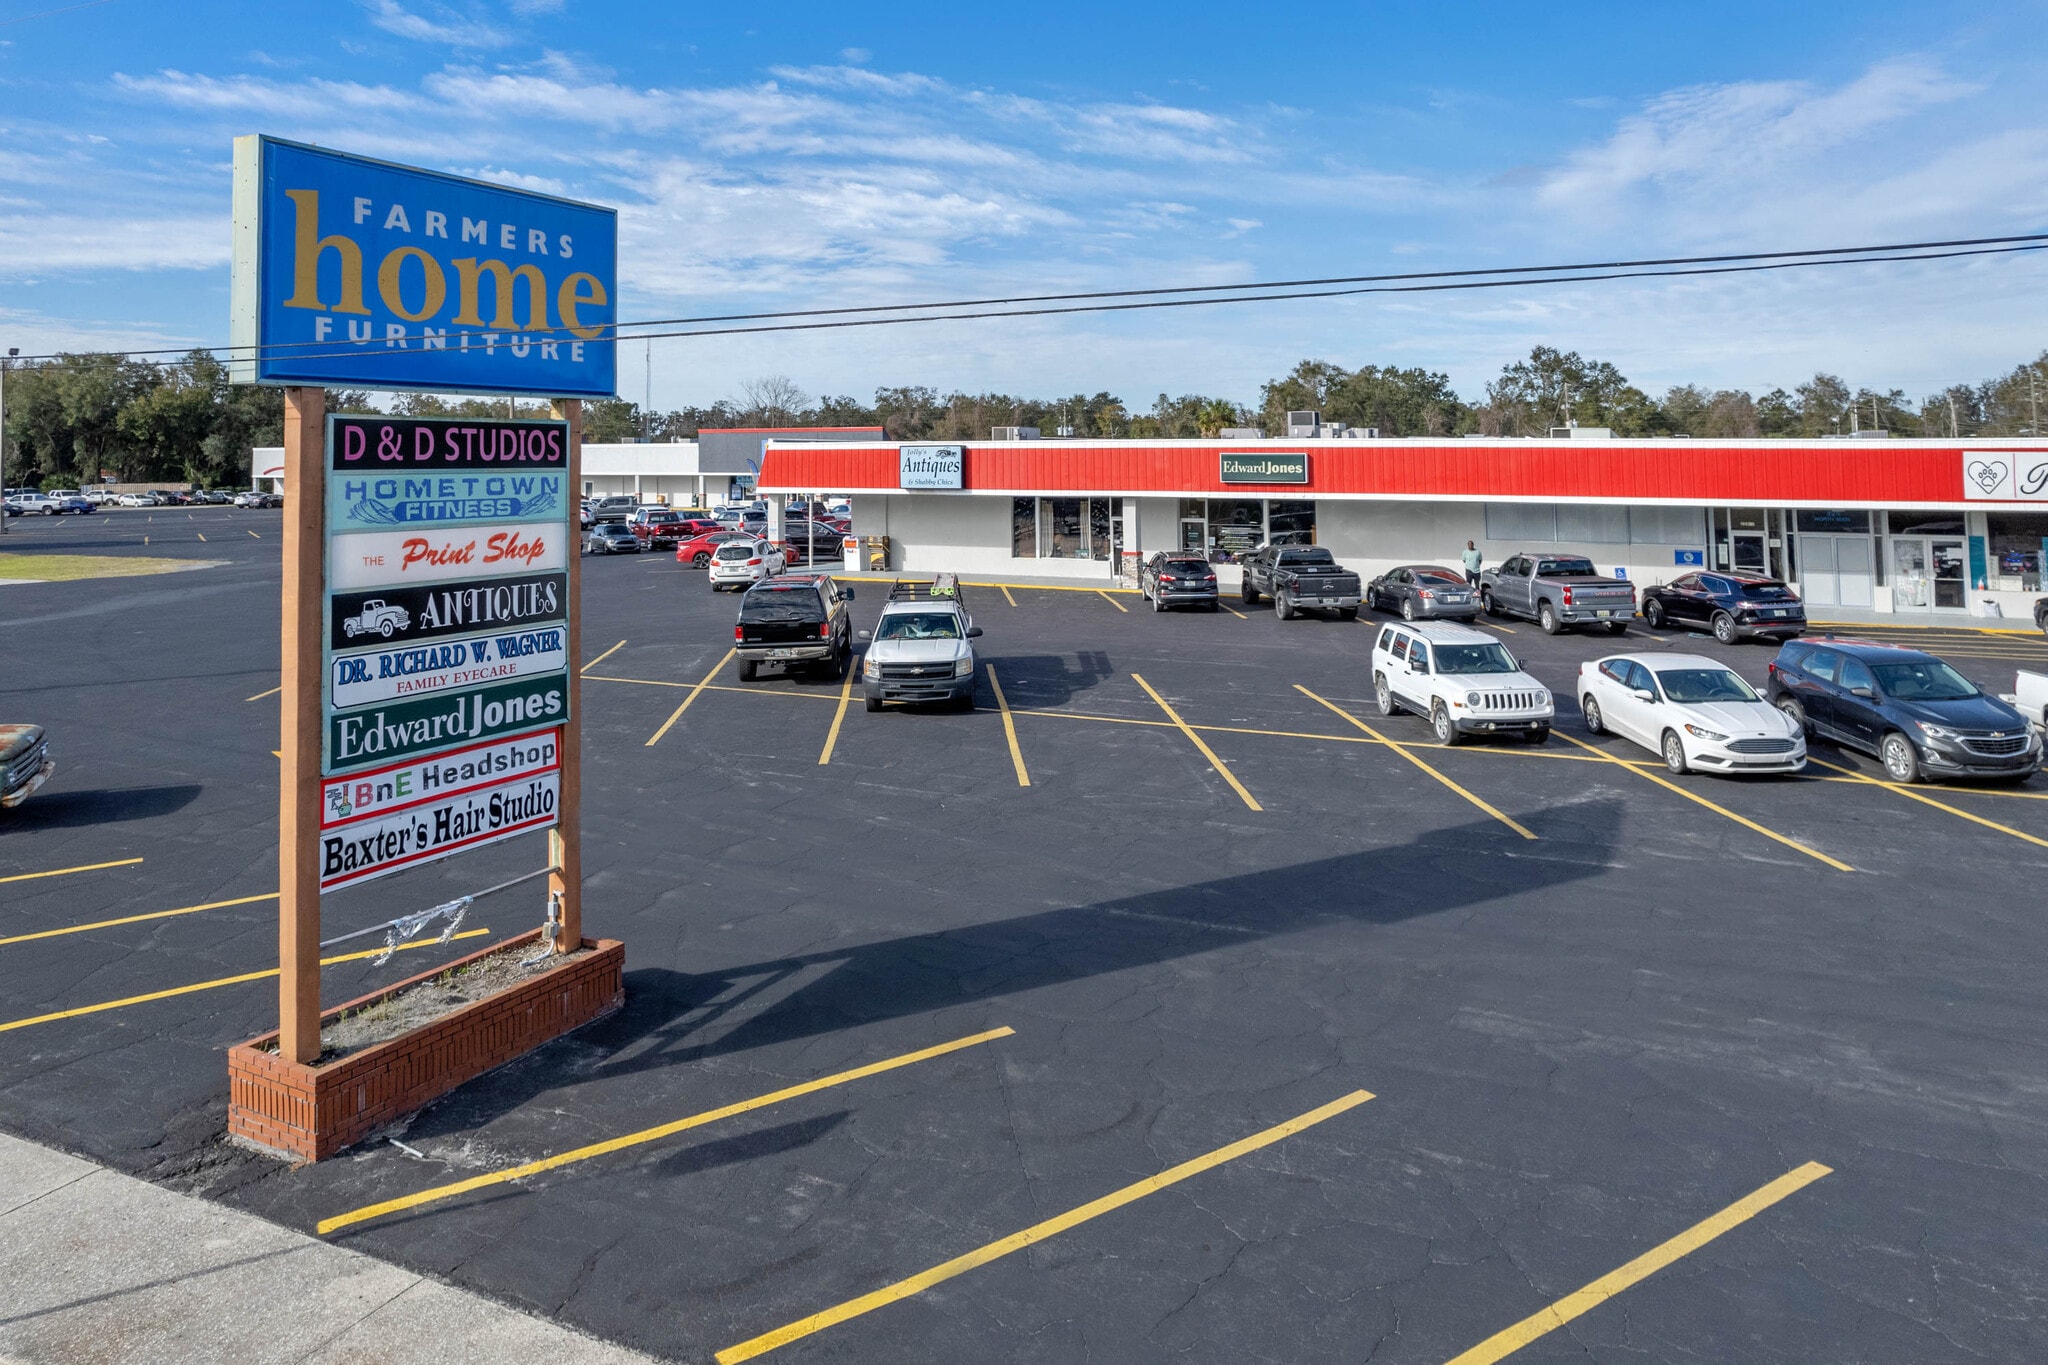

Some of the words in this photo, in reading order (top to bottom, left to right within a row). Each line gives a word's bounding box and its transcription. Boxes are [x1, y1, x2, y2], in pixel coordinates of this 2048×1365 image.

[354, 196, 573, 258] FARMERS
[283, 189, 608, 339] home
[315, 316, 584, 363] FURNITURE
[344, 425, 366, 461] D
[377, 425, 404, 461] &
[415, 427, 435, 461] D
[445, 427, 560, 462] STUDIOS
[345, 476, 559, 500] HOMETOWN
[902, 457, 960, 478] Antiques
[405, 499, 511, 520] FITNESS
[363, 556, 385, 567] THE
[402, 538, 476, 571] Print
[483, 532, 545, 566] Shop
[420, 581, 557, 630] ANTIQUES
[338, 660, 373, 686] DR.
[379, 644, 466, 679] RICHARD
[471, 641, 492, 663] W.
[496, 631, 562, 658] WAGNER
[397, 675, 449, 694] FAMILY
[454, 664, 517, 683] EYECARE
[355, 771, 413, 809] BnE
[422, 743, 555, 790] Headshop
[322, 816, 428, 878] Baxter's
[432, 800, 485, 845] Hair
[488, 781, 554, 829] Studio
